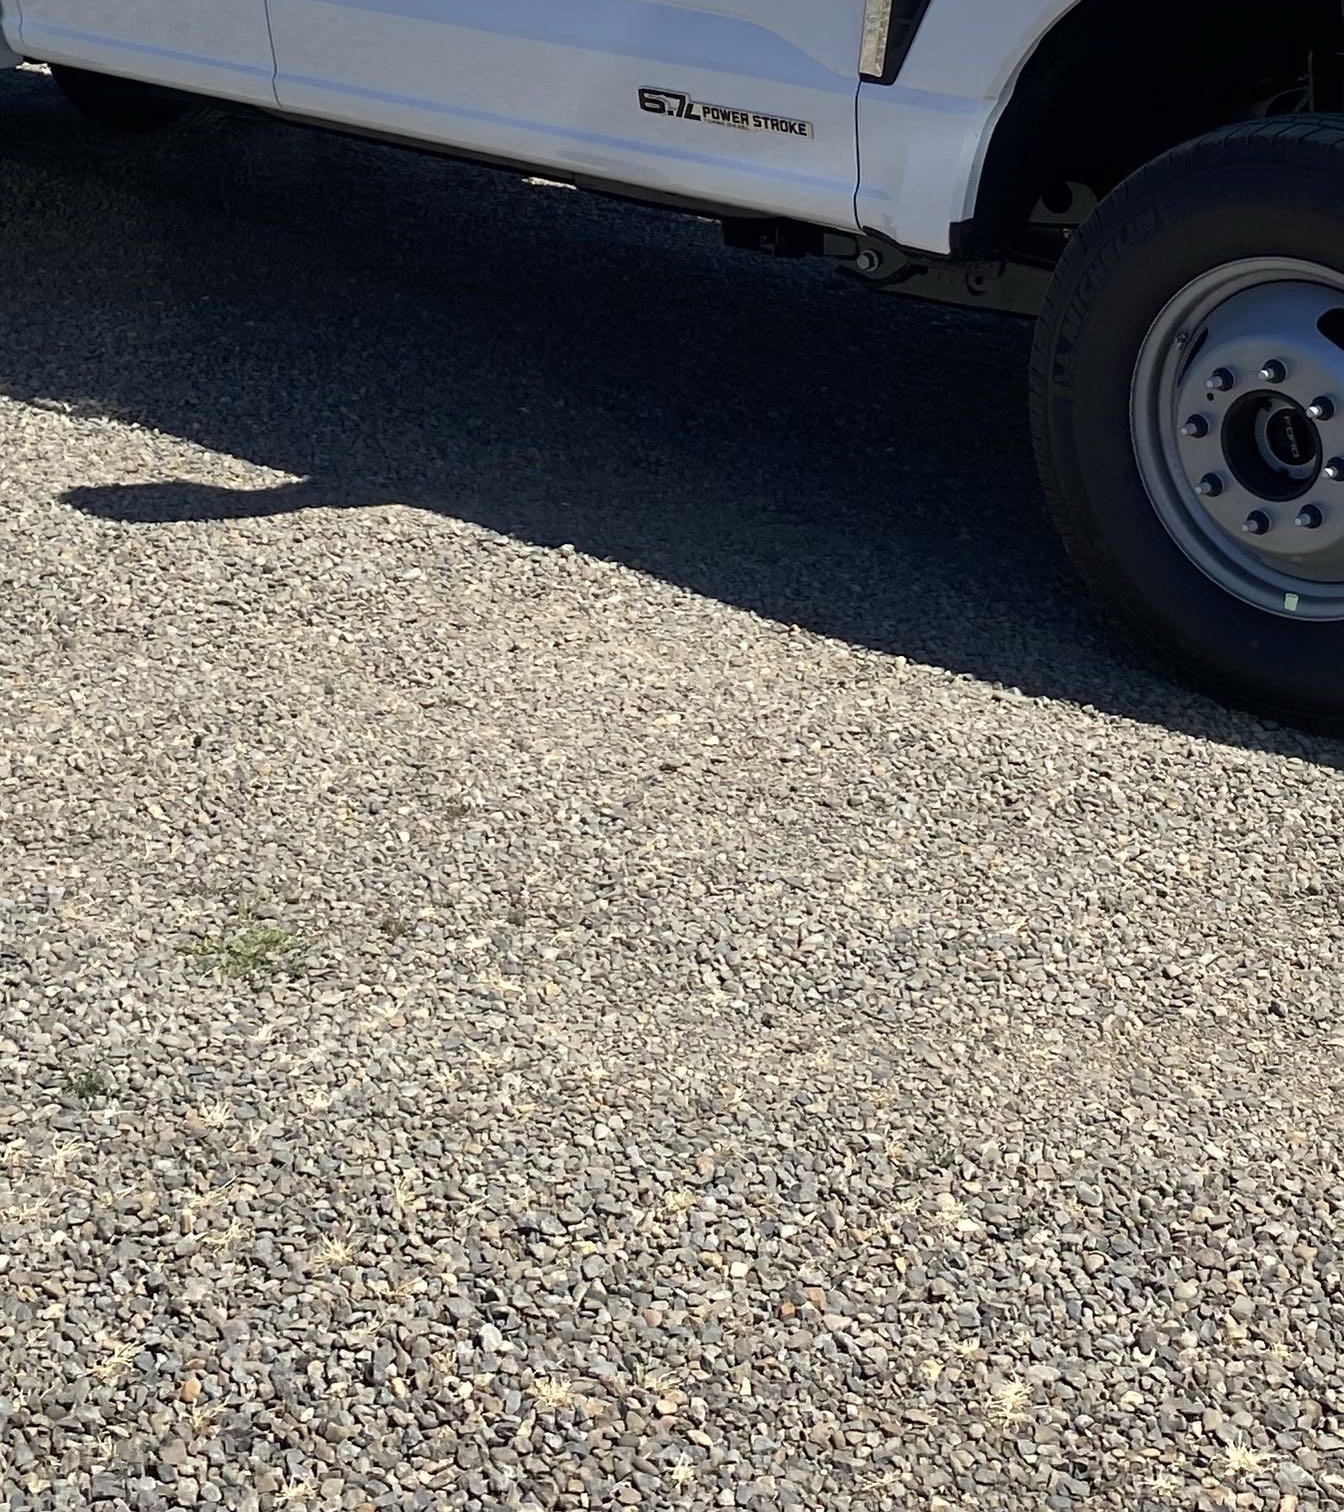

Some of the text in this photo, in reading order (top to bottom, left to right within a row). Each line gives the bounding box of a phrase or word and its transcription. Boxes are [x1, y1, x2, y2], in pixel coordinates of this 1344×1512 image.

[638, 88, 701, 121] 6.7L
[702, 105, 750, 126] POWER
[753, 115, 808, 136] STROKE
